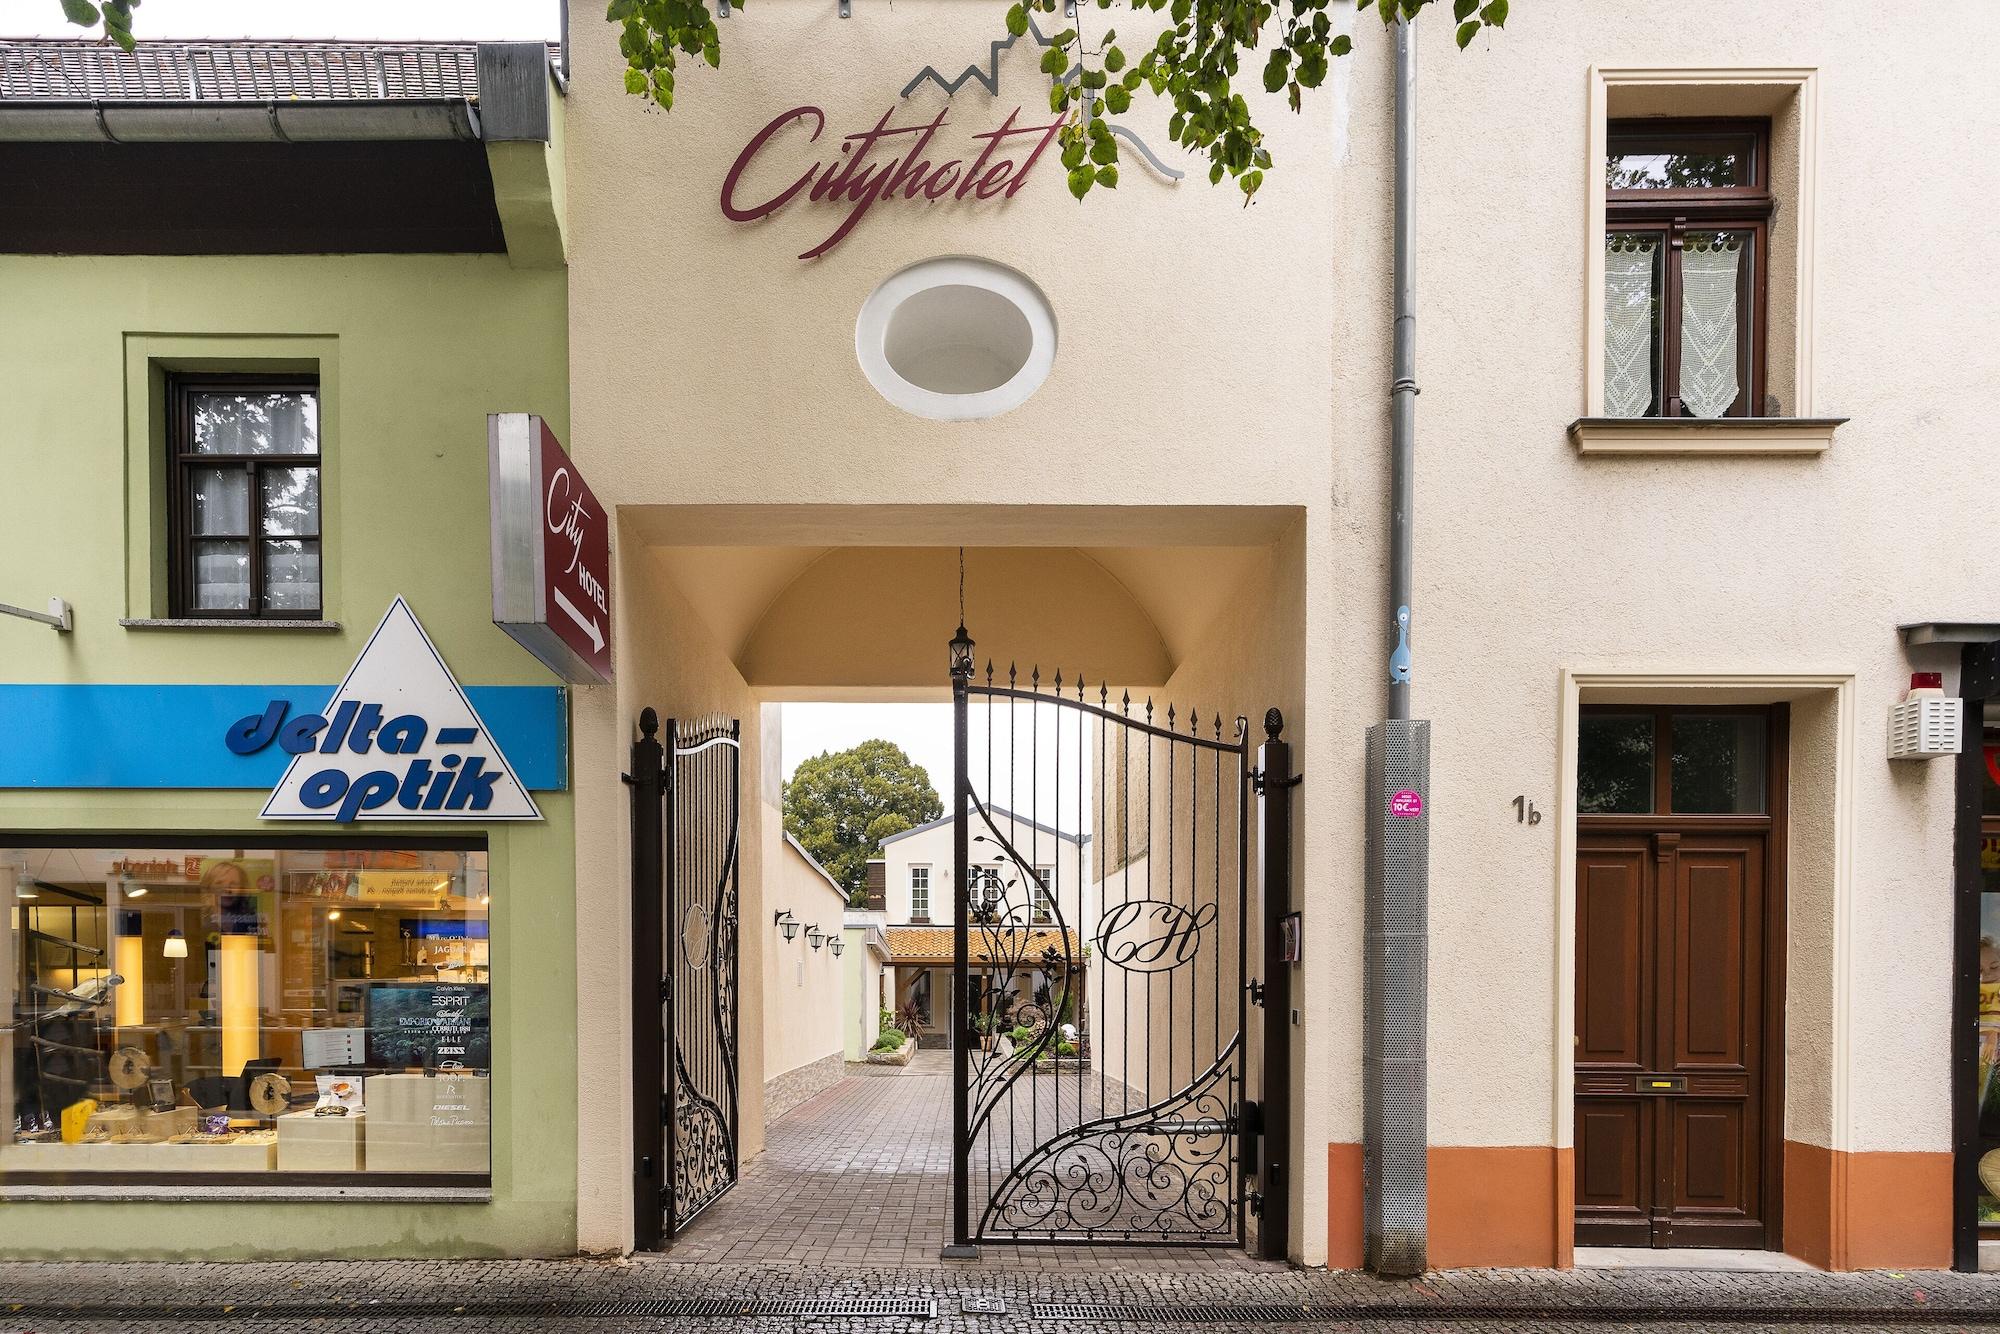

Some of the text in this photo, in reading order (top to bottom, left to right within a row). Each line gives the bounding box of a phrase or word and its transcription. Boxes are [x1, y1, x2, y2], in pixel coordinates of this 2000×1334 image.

[720, 105, 1071, 260] Cityhotel
[547, 467, 592, 574] City
[578, 561, 608, 616] HOTEL
[299, 753, 504, 824] optik
[1512, 795, 1542, 826] 1b
[400, 1018, 433, 1026] EMPORIO
[432, 996, 470, 1006] ESPRIT
[437, 1047, 465, 1055] ZEISS
